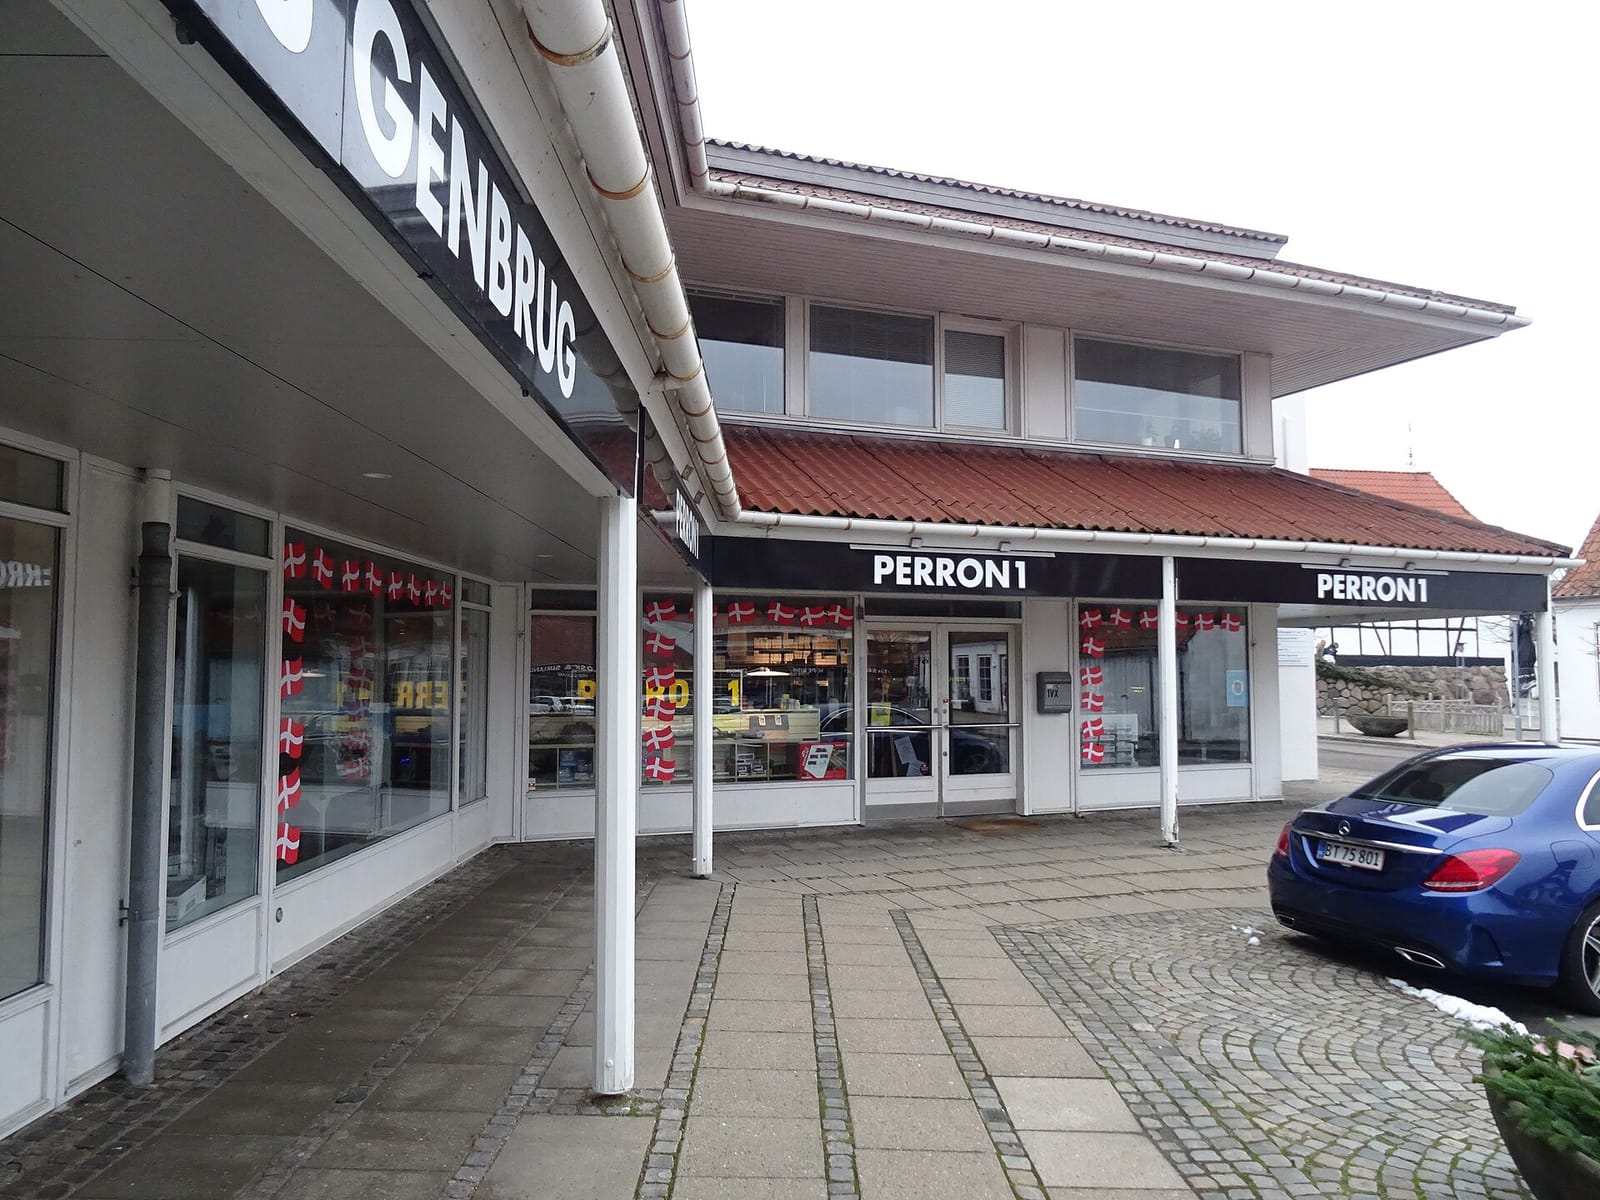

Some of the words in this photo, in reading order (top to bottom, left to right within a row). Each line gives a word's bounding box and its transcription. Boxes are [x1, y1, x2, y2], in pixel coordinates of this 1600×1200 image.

[353, 0, 577, 399] GENBRUG
[1325, 844, 1340, 858] BT
[1342, 846, 1356, 861] 75
[1358, 850, 1379, 866] 801
